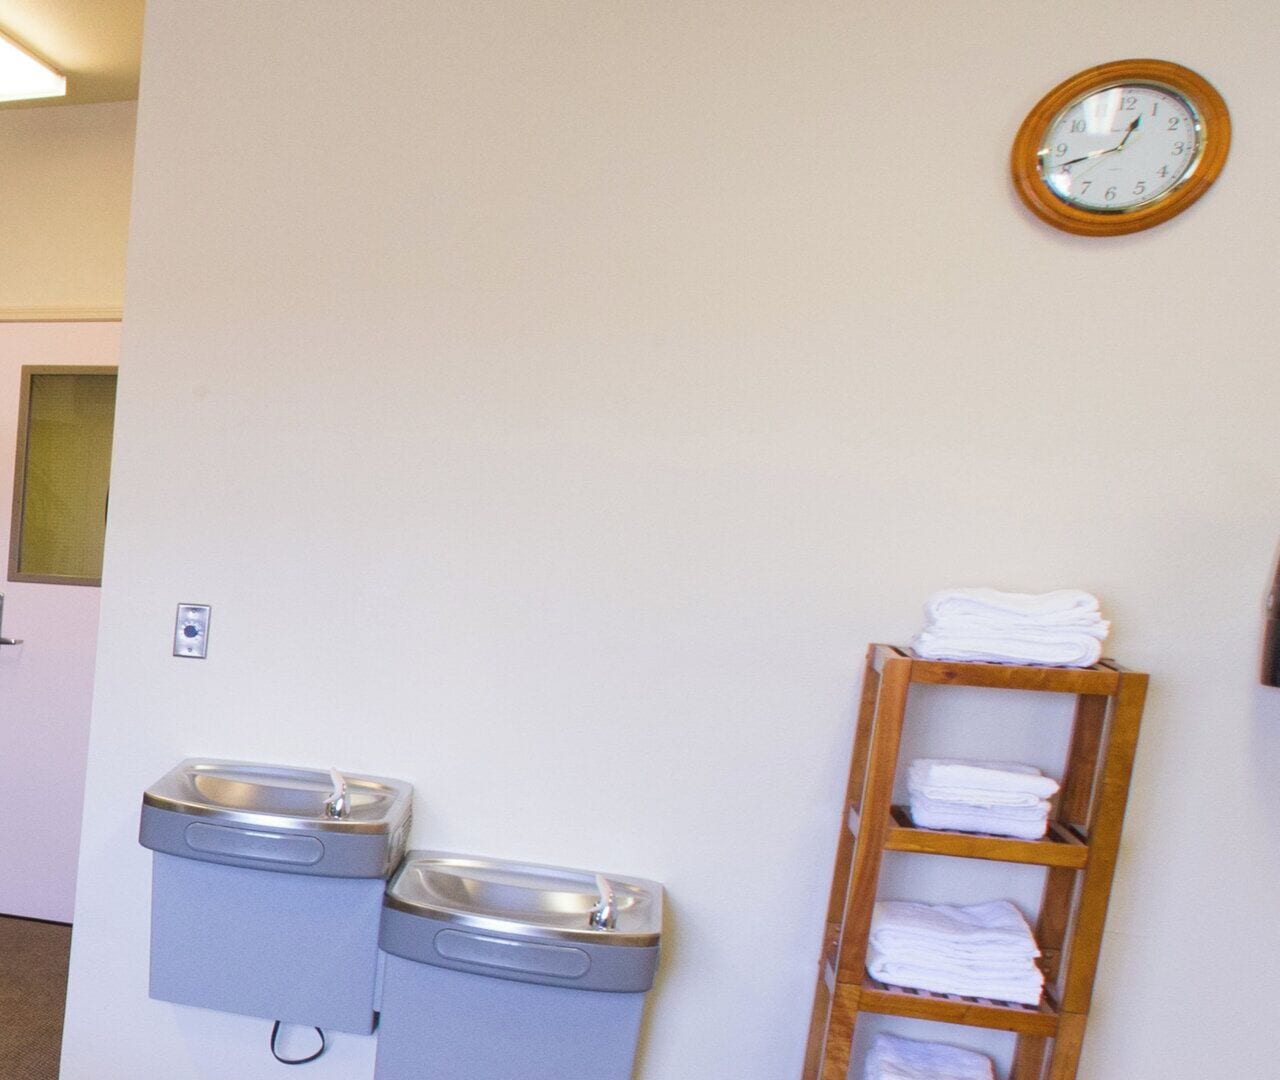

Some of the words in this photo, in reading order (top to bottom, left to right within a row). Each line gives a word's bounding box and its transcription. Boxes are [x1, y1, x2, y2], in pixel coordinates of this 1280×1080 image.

[1119, 97, 1137, 111] 12
[1151, 102, 1159, 117] 1
[1071, 120, 1086, 133] 10
[1168, 117, 1179, 131] 2
[1056, 143, 1068, 157] 9
[1171, 142, 1184, 155] 3
[1157, 165, 1168, 178] 4
[1081, 181, 1092, 195] 7
[1104, 186, 1117, 200] 6
[1132, 181, 1146, 195] 5
